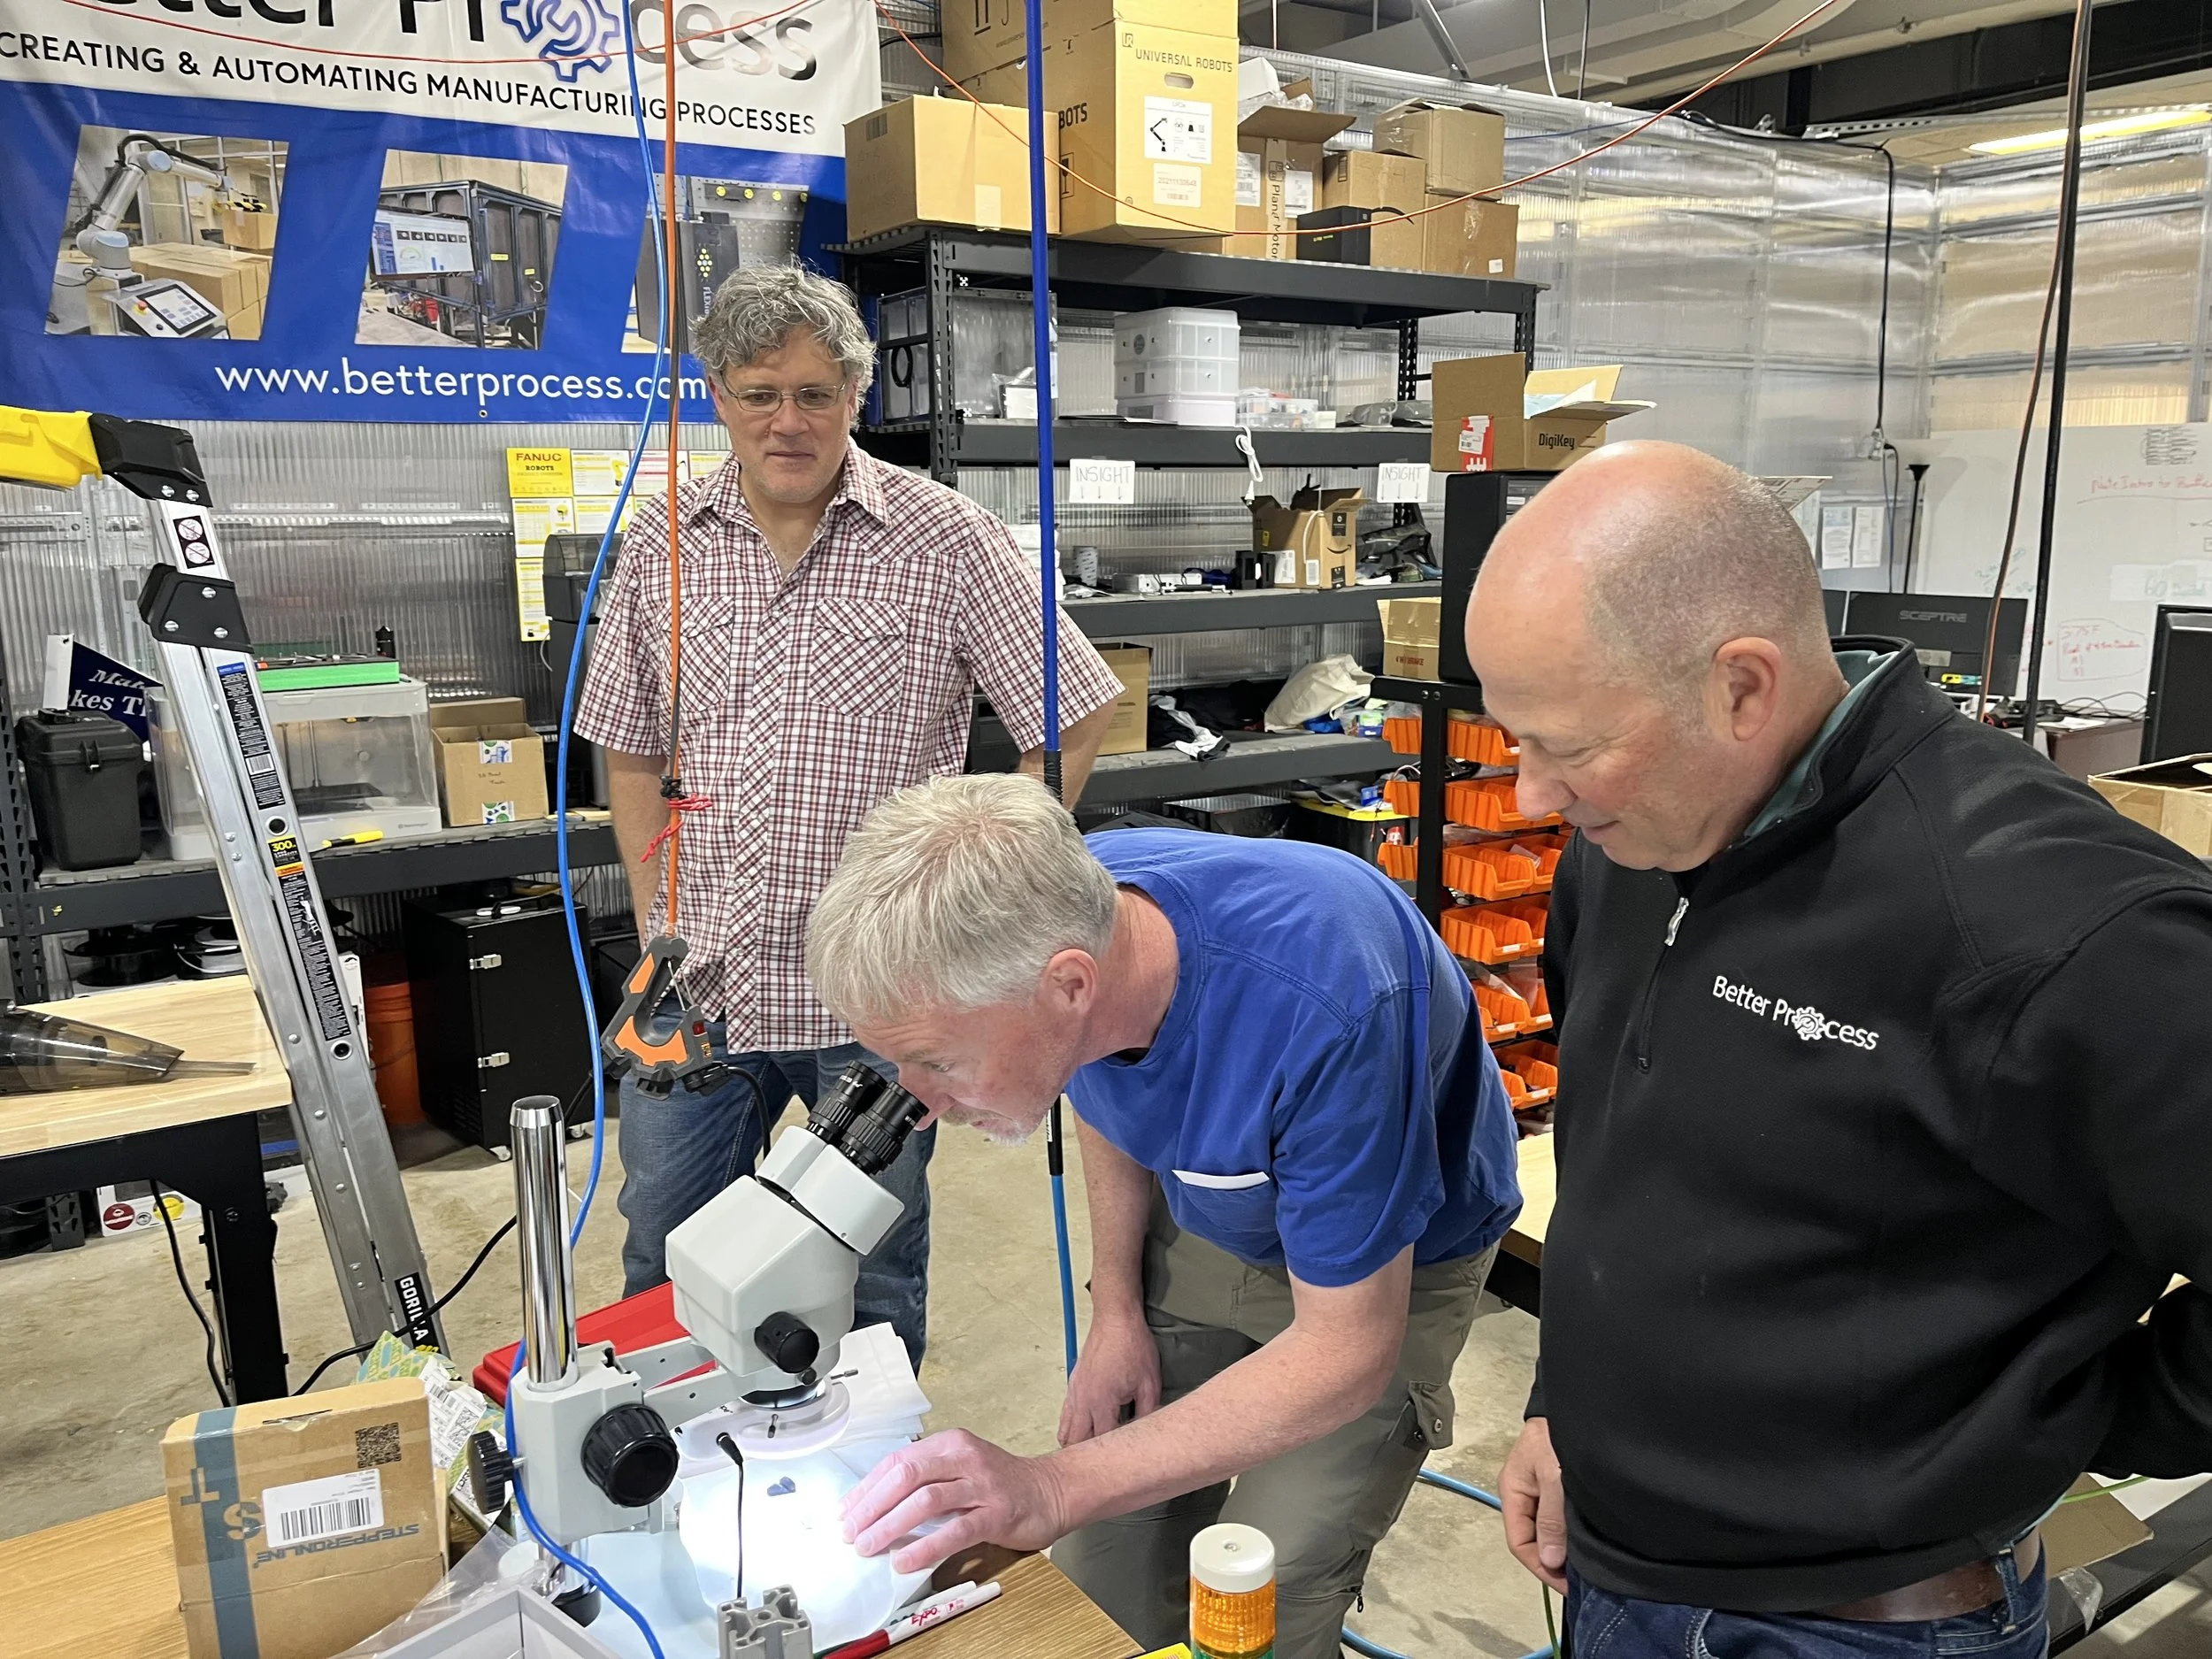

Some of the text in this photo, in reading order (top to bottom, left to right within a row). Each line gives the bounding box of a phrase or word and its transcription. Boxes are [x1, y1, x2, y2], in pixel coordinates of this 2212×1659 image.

[1135, 48, 1233, 73] UNIVERSAL ROBOTS
[0, 32, 817, 135] CREATING & AUTOMATING MANUFACTURING PROCESSES
[1058, 102, 1088, 129] BOTS
[215, 357, 708, 405] www.betterprocess.com
[1539, 434, 1575, 450] DigiKey
[516, 453, 562, 462] FANUC
[1075, 465, 1131, 483] INSIGHT
[1381, 466, 1426, 482] INSIGHT
[1899, 611, 1968, 623] SCEPTRE
[69, 690, 114, 710] kes
[271, 840, 293, 852] 300
[1712, 975, 1879, 1050] Better Process
[256, 1523, 419, 1563] STEPPERONLINE
[911, 1607, 938, 1625] EXPO
